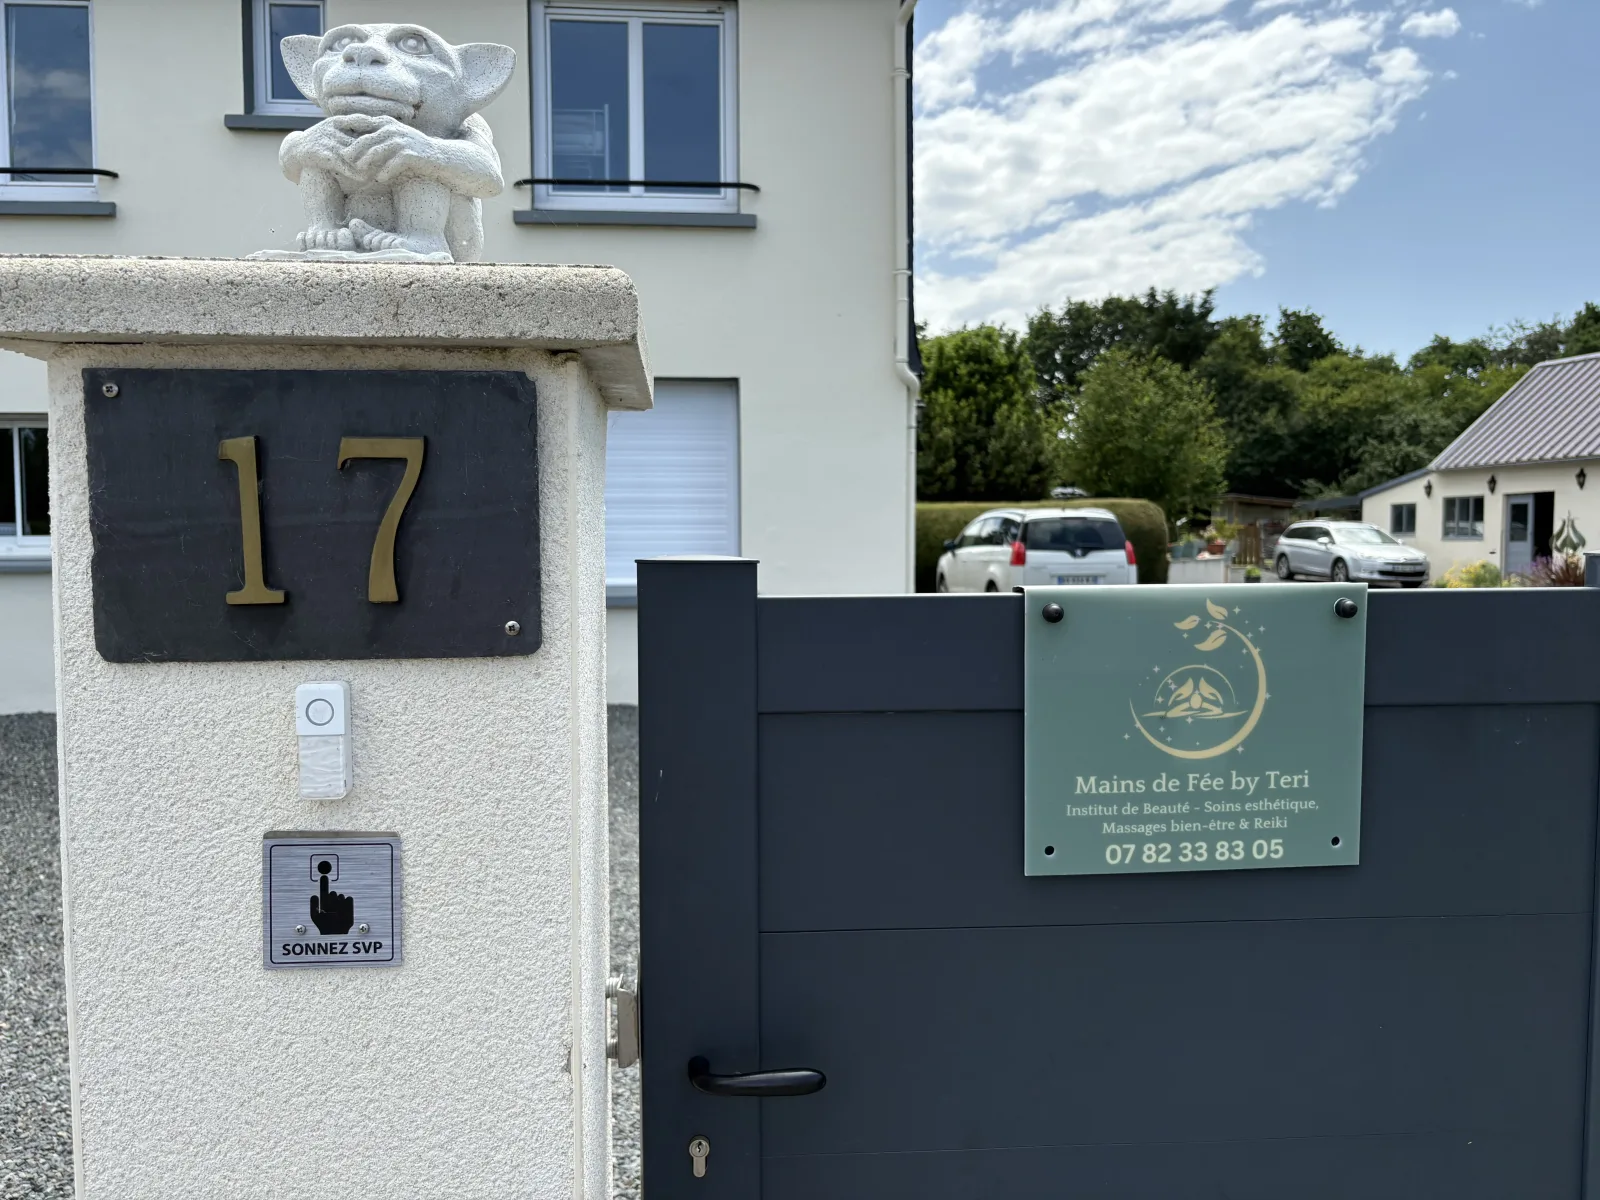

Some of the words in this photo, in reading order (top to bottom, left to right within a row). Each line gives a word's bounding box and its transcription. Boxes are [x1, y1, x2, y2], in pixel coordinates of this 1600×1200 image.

[218, 435, 427, 606] 17
[1074, 775, 1146, 794] Mains
[1152, 772, 1180, 792] de
[1187, 773, 1224, 792] Fée
[1230, 770, 1260, 796] by
[1265, 769, 1310, 789] Teri
[1066, 804, 1118, 816] Institut
[1121, 802, 1139, 815] de
[1143, 802, 1190, 815] Beauté
[1204, 801, 1241, 812] Soins
[1244, 798, 1319, 814] esthétique,
[1102, 822, 1167, 836] Massages
[1170, 819, 1236, 832] bien-être
[1239, 818, 1249, 830] &
[1254, 816, 1288, 829] Reiki
[1105, 844, 1136, 865] 07
[1142, 842, 1172, 864] 82
[1178, 841, 1208, 863] 33
[1215, 840, 1245, 861] 83
[1252, 839, 1284, 860] 05
[282, 942, 349, 956] SONNEZ
[352, 941, 383, 954] SVP
